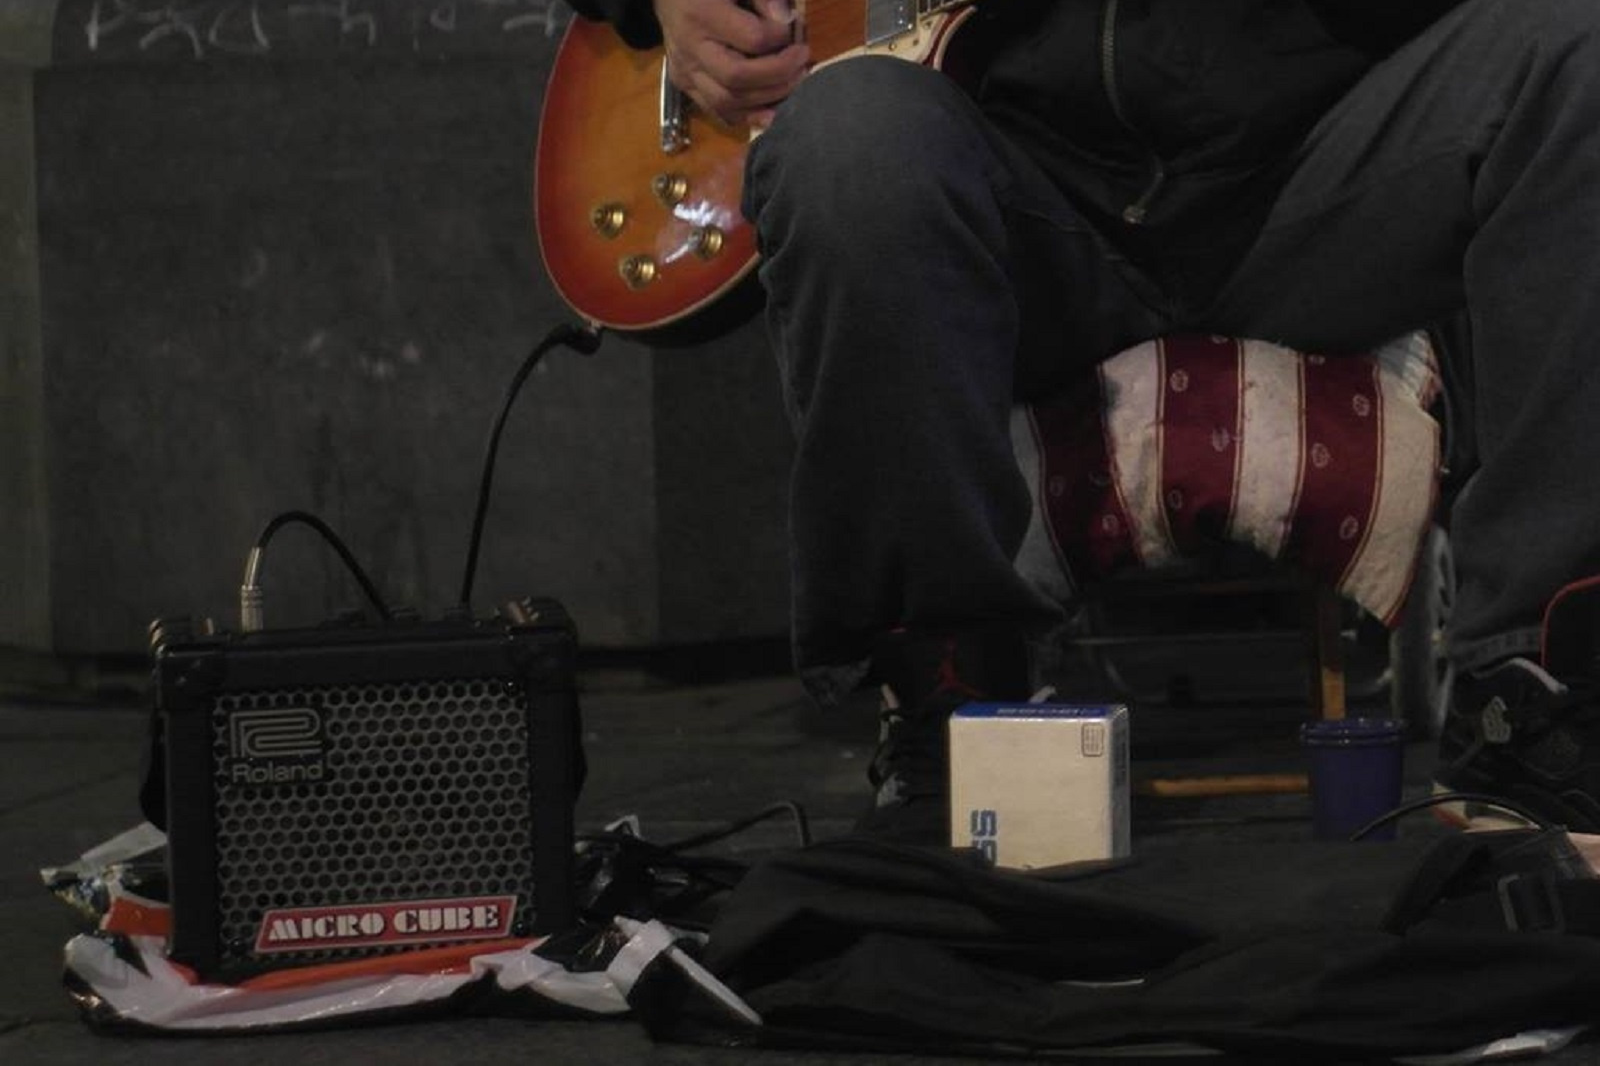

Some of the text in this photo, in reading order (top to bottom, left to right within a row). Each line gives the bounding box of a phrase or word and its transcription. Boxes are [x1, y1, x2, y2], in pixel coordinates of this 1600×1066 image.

[232, 760, 324, 784] Roland
[267, 904, 500, 942] MICRO CUBE
